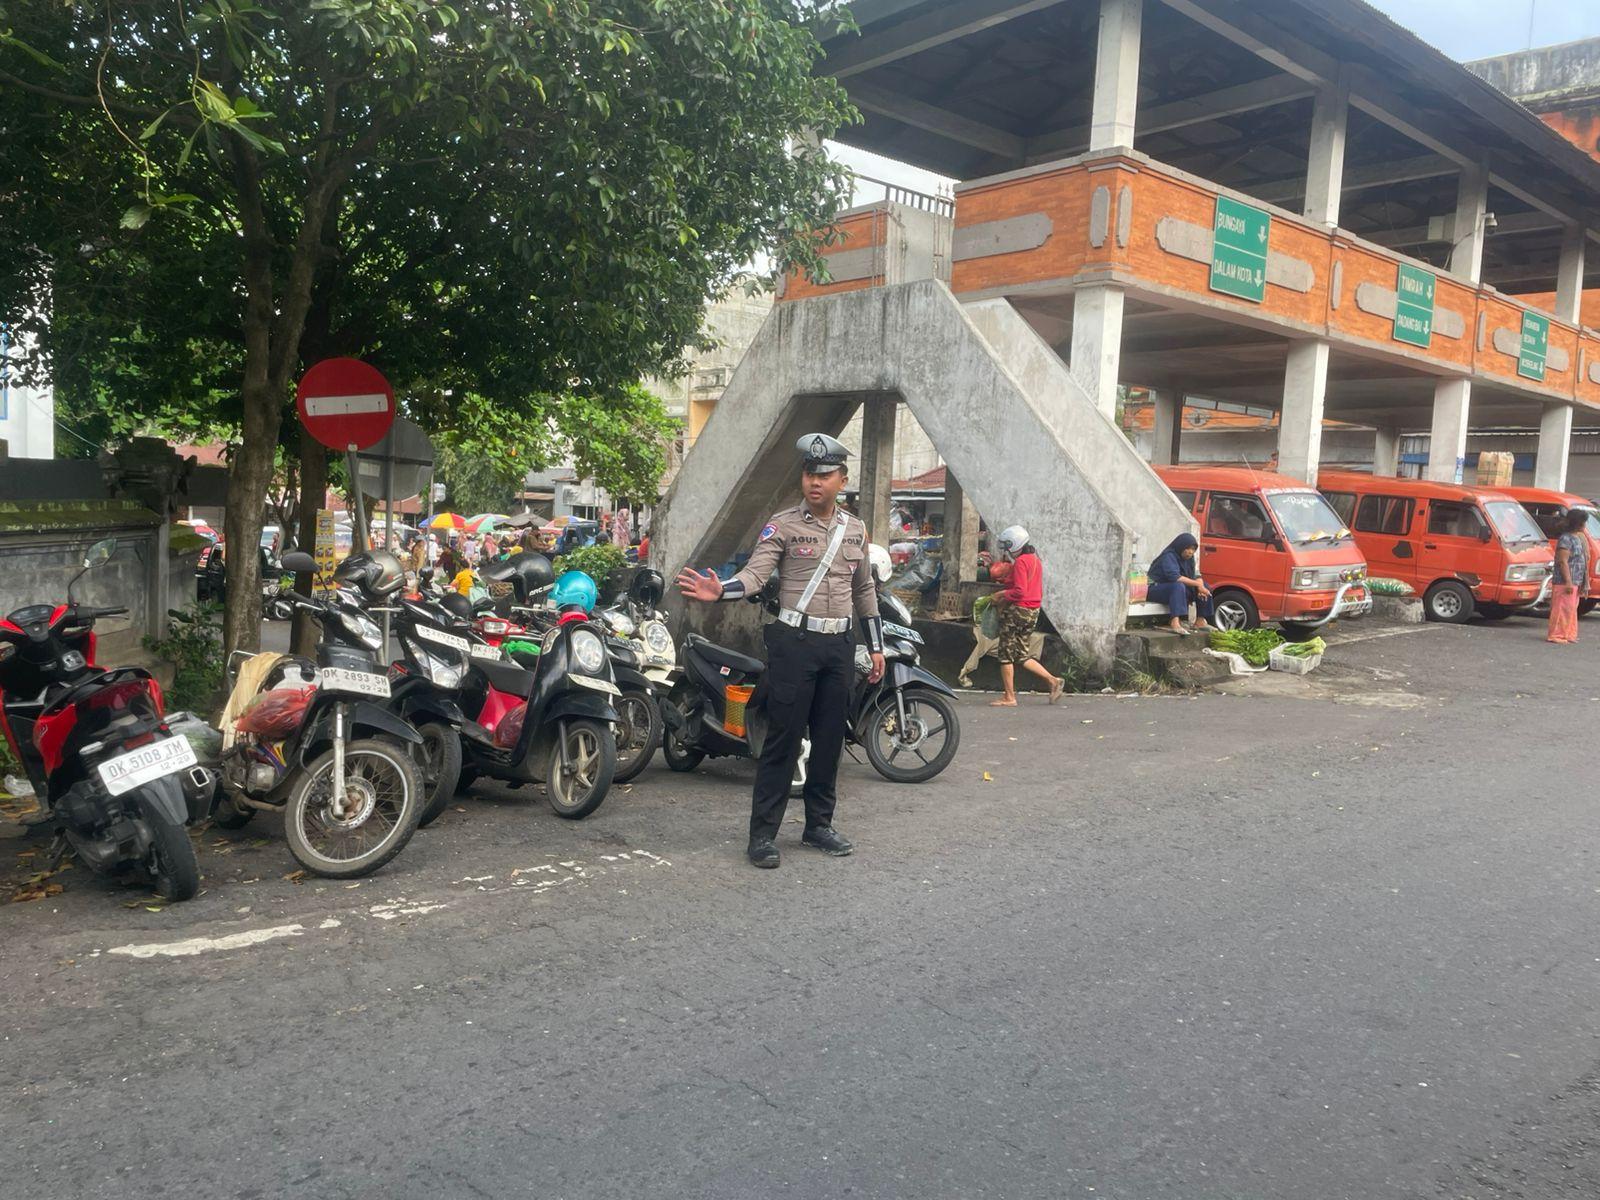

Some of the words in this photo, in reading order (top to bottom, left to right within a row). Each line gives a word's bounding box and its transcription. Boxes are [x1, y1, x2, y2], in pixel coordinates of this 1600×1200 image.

[1214, 259, 1236, 279] DALAM
[1237, 265, 1252, 284] KOTA
[791, 536, 818, 544] AGUS
[324, 669, 338, 678] DK
[344, 671, 370, 682] 2893
[108, 760, 127, 777] DK
[129, 748, 161, 769] 5108
[164, 739, 184, 756] TM
